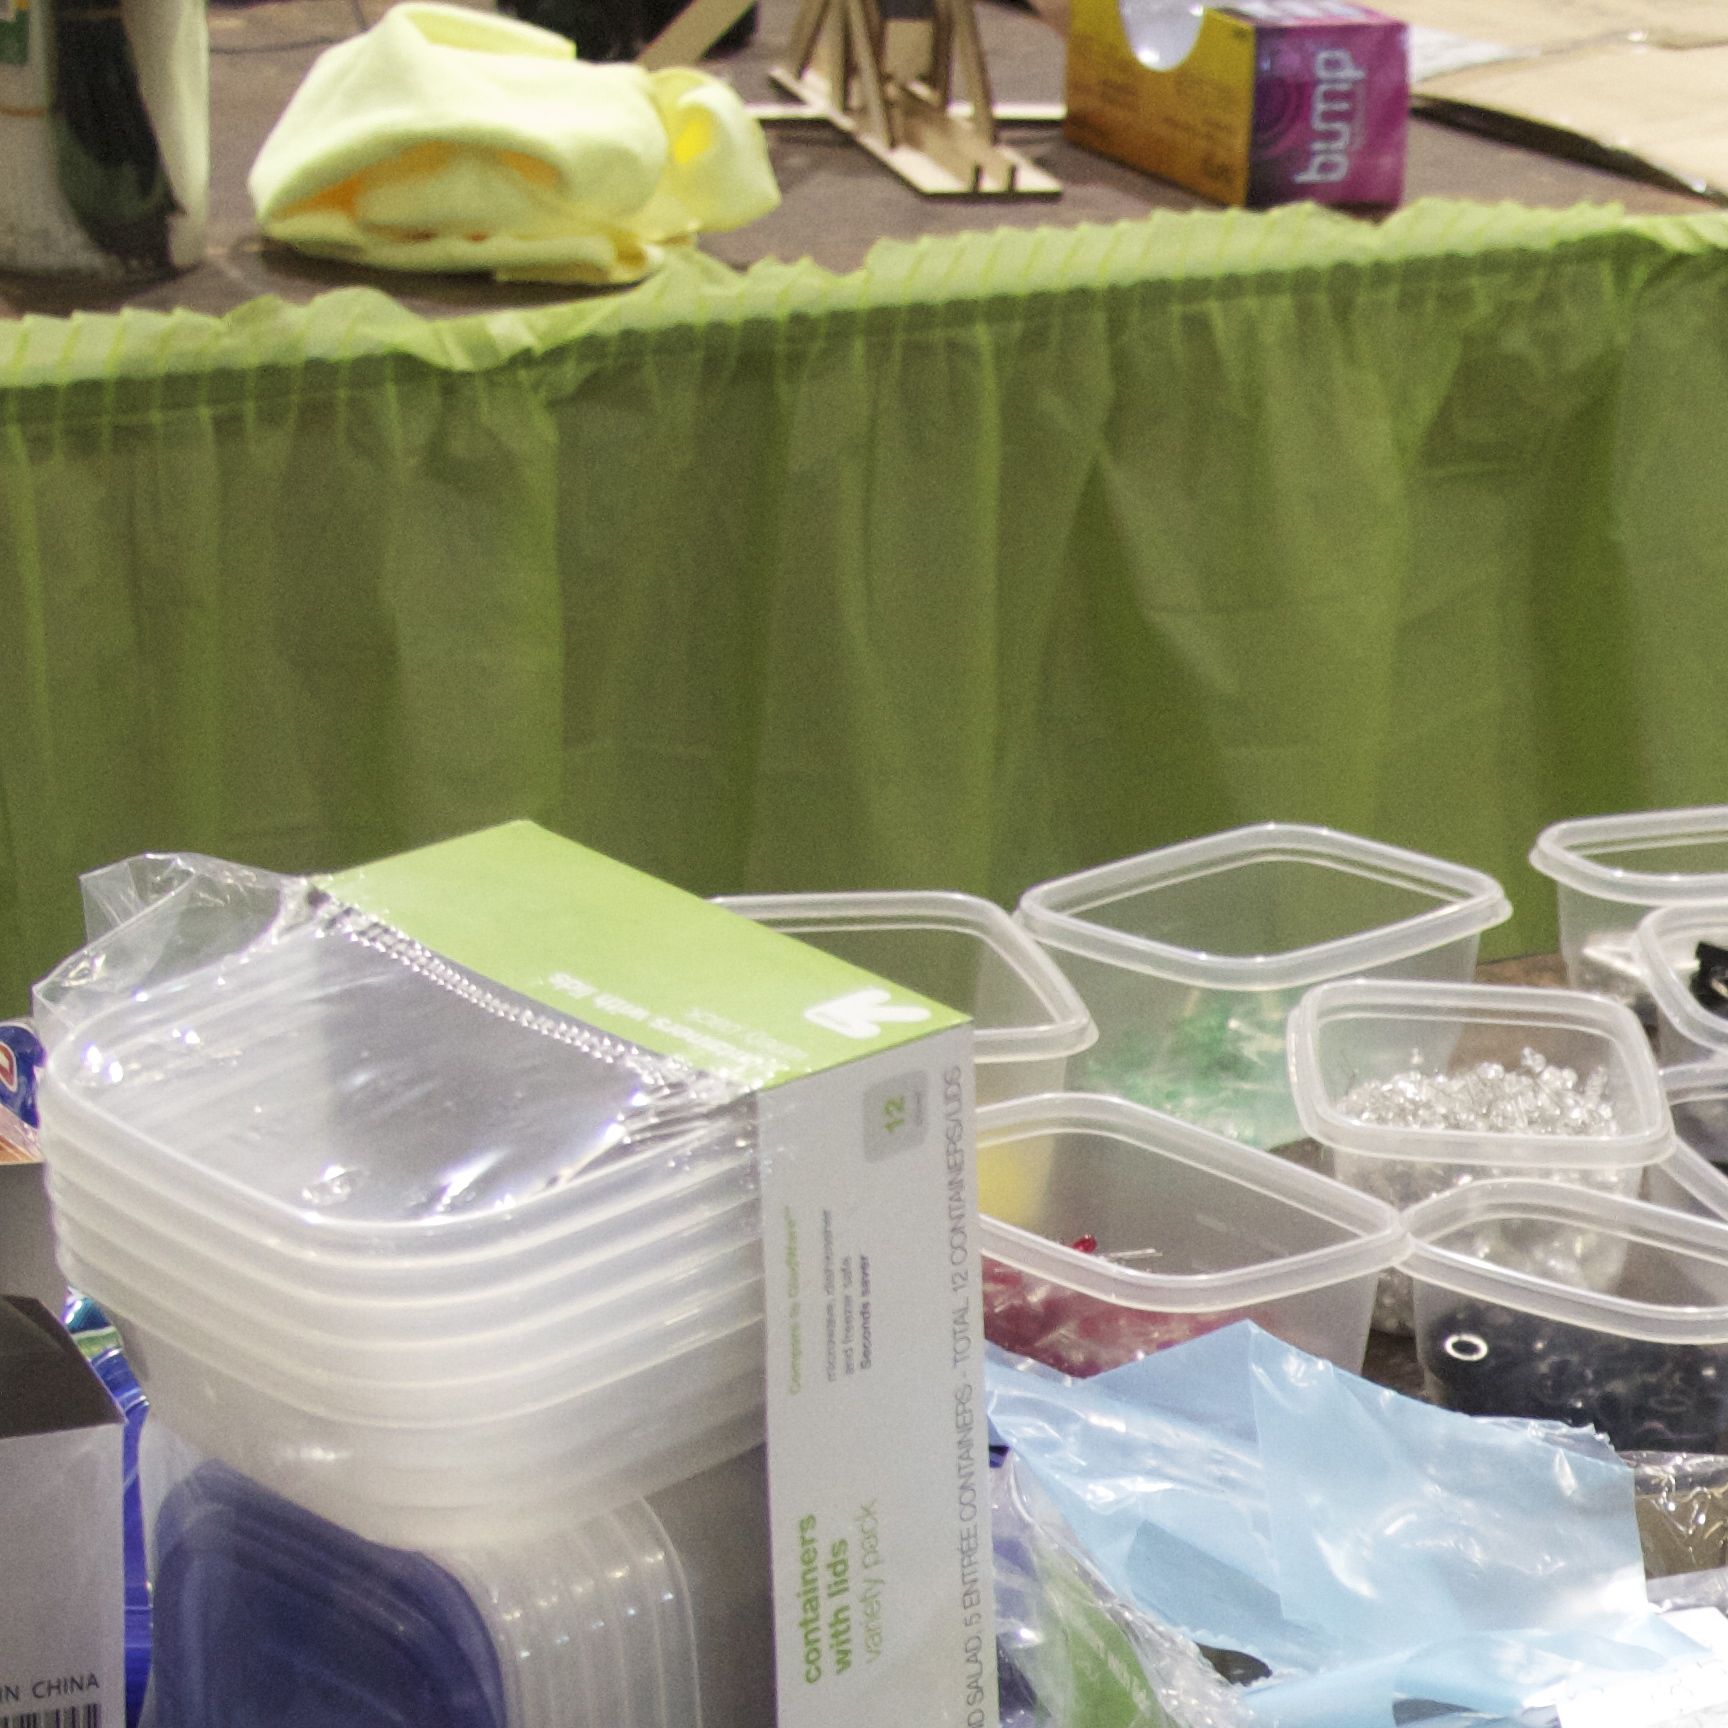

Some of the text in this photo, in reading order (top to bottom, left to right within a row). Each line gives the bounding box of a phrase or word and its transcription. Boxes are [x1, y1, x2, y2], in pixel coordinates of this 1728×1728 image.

[1294, 48, 1365, 184] bump
[883, 1096, 905, 1133] 12
[944, 1065, 968, 1266] CONTAINERS/LIDS
[858, 1255, 872, 1370] Seconds saver
[951, 1269, 969, 1293] 12
[952, 1297, 972, 1369] TOTAL
[954, 1383, 977, 1522] CONTAINERS
[795, 1513, 822, 1685] containers
[826, 1537, 853, 1675] with lids
[856, 1499, 886, 1665] variety pack
[957, 1524, 981, 1610] ENTRÉE
[964, 1611, 982, 1627] 5
[32, 1671, 100, 1699] CHINA
